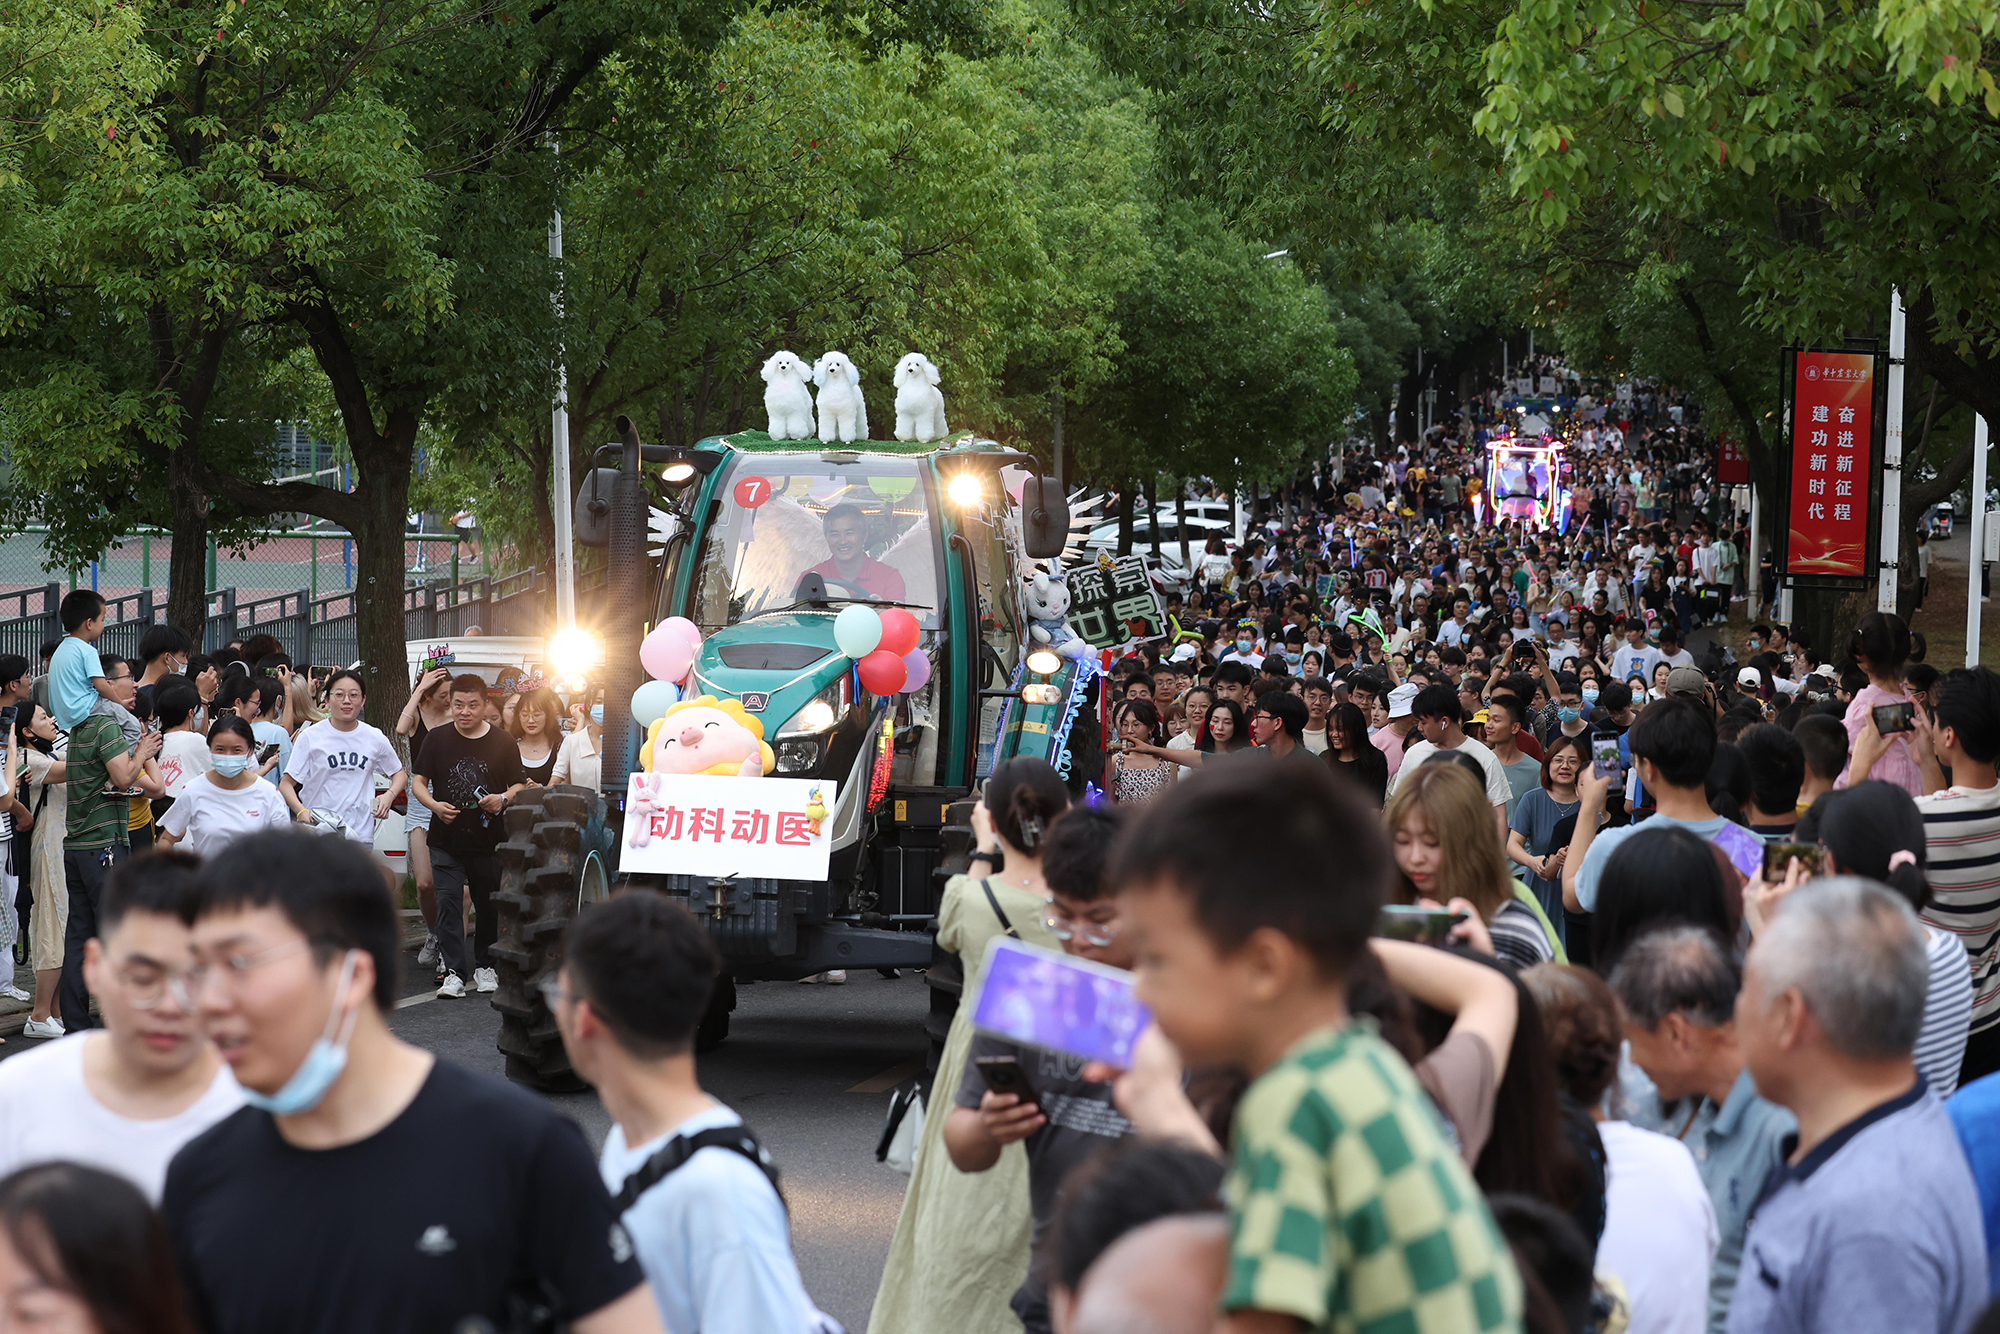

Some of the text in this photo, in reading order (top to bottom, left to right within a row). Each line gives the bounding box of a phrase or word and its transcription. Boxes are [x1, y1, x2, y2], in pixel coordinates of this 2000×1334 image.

[1808, 405, 1829, 519] 建功新时代
[1834, 406, 1855, 521] 奋进新征程
[745, 481, 761, 502] 7
[1070, 561, 1148, 604] 探索
[1063, 594, 1161, 648] 世界
[327, 752, 369, 770] OIOI
[650, 806, 821, 846] 动科动医
